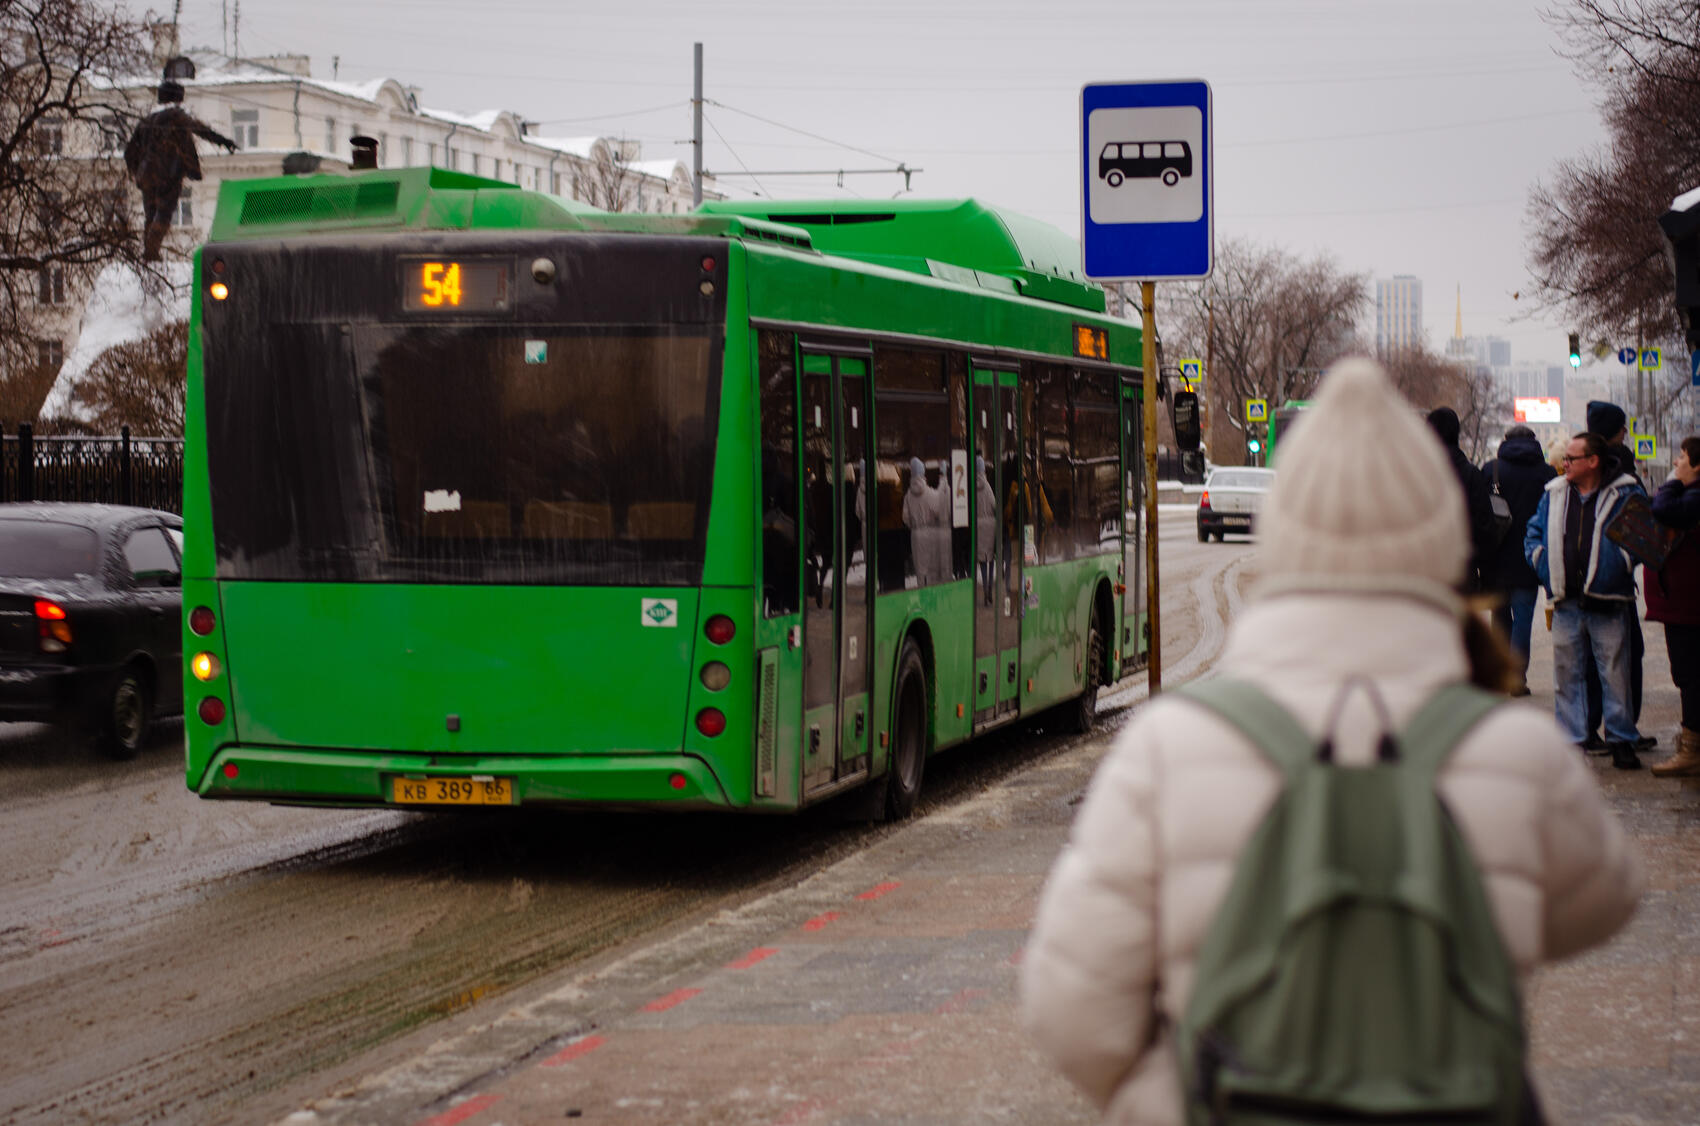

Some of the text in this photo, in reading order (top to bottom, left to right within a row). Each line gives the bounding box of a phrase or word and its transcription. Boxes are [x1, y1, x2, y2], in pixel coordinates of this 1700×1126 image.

[423, 262, 461, 306] 54
[436, 780, 474, 801] 389
[485, 779, 505, 796] 66
